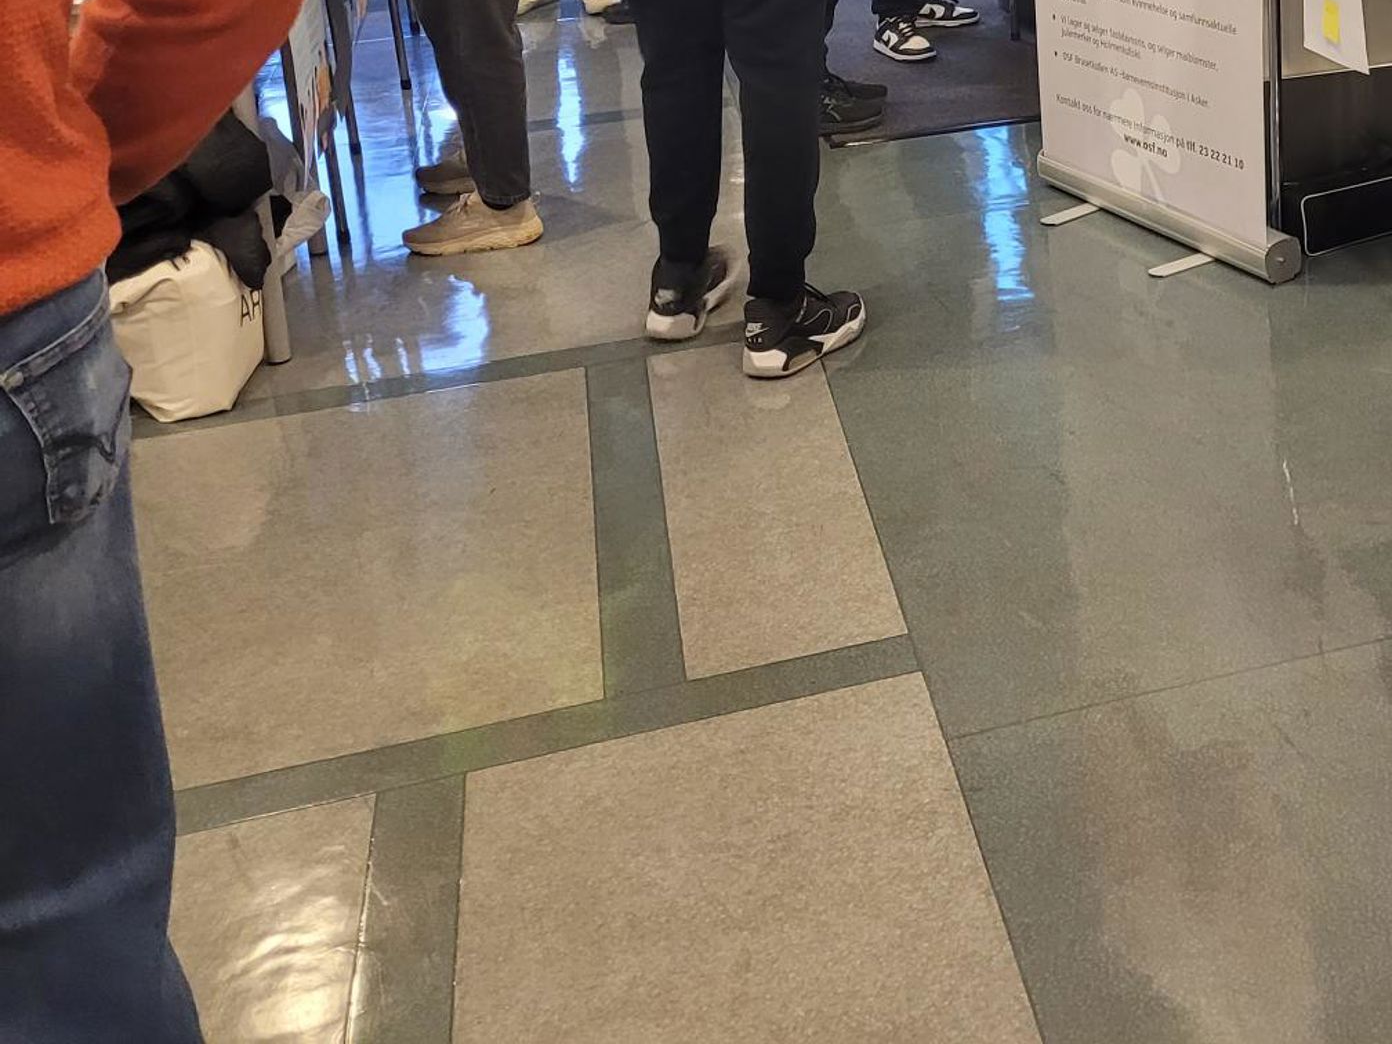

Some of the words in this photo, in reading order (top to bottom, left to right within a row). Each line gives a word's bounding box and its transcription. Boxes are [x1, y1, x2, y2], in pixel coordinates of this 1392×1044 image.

[1199, 145, 1209, 157] 23
[1210, 149, 1220, 161] 22
[1222, 153, 1231, 165] 21
[1234, 157, 1244, 170] 10
